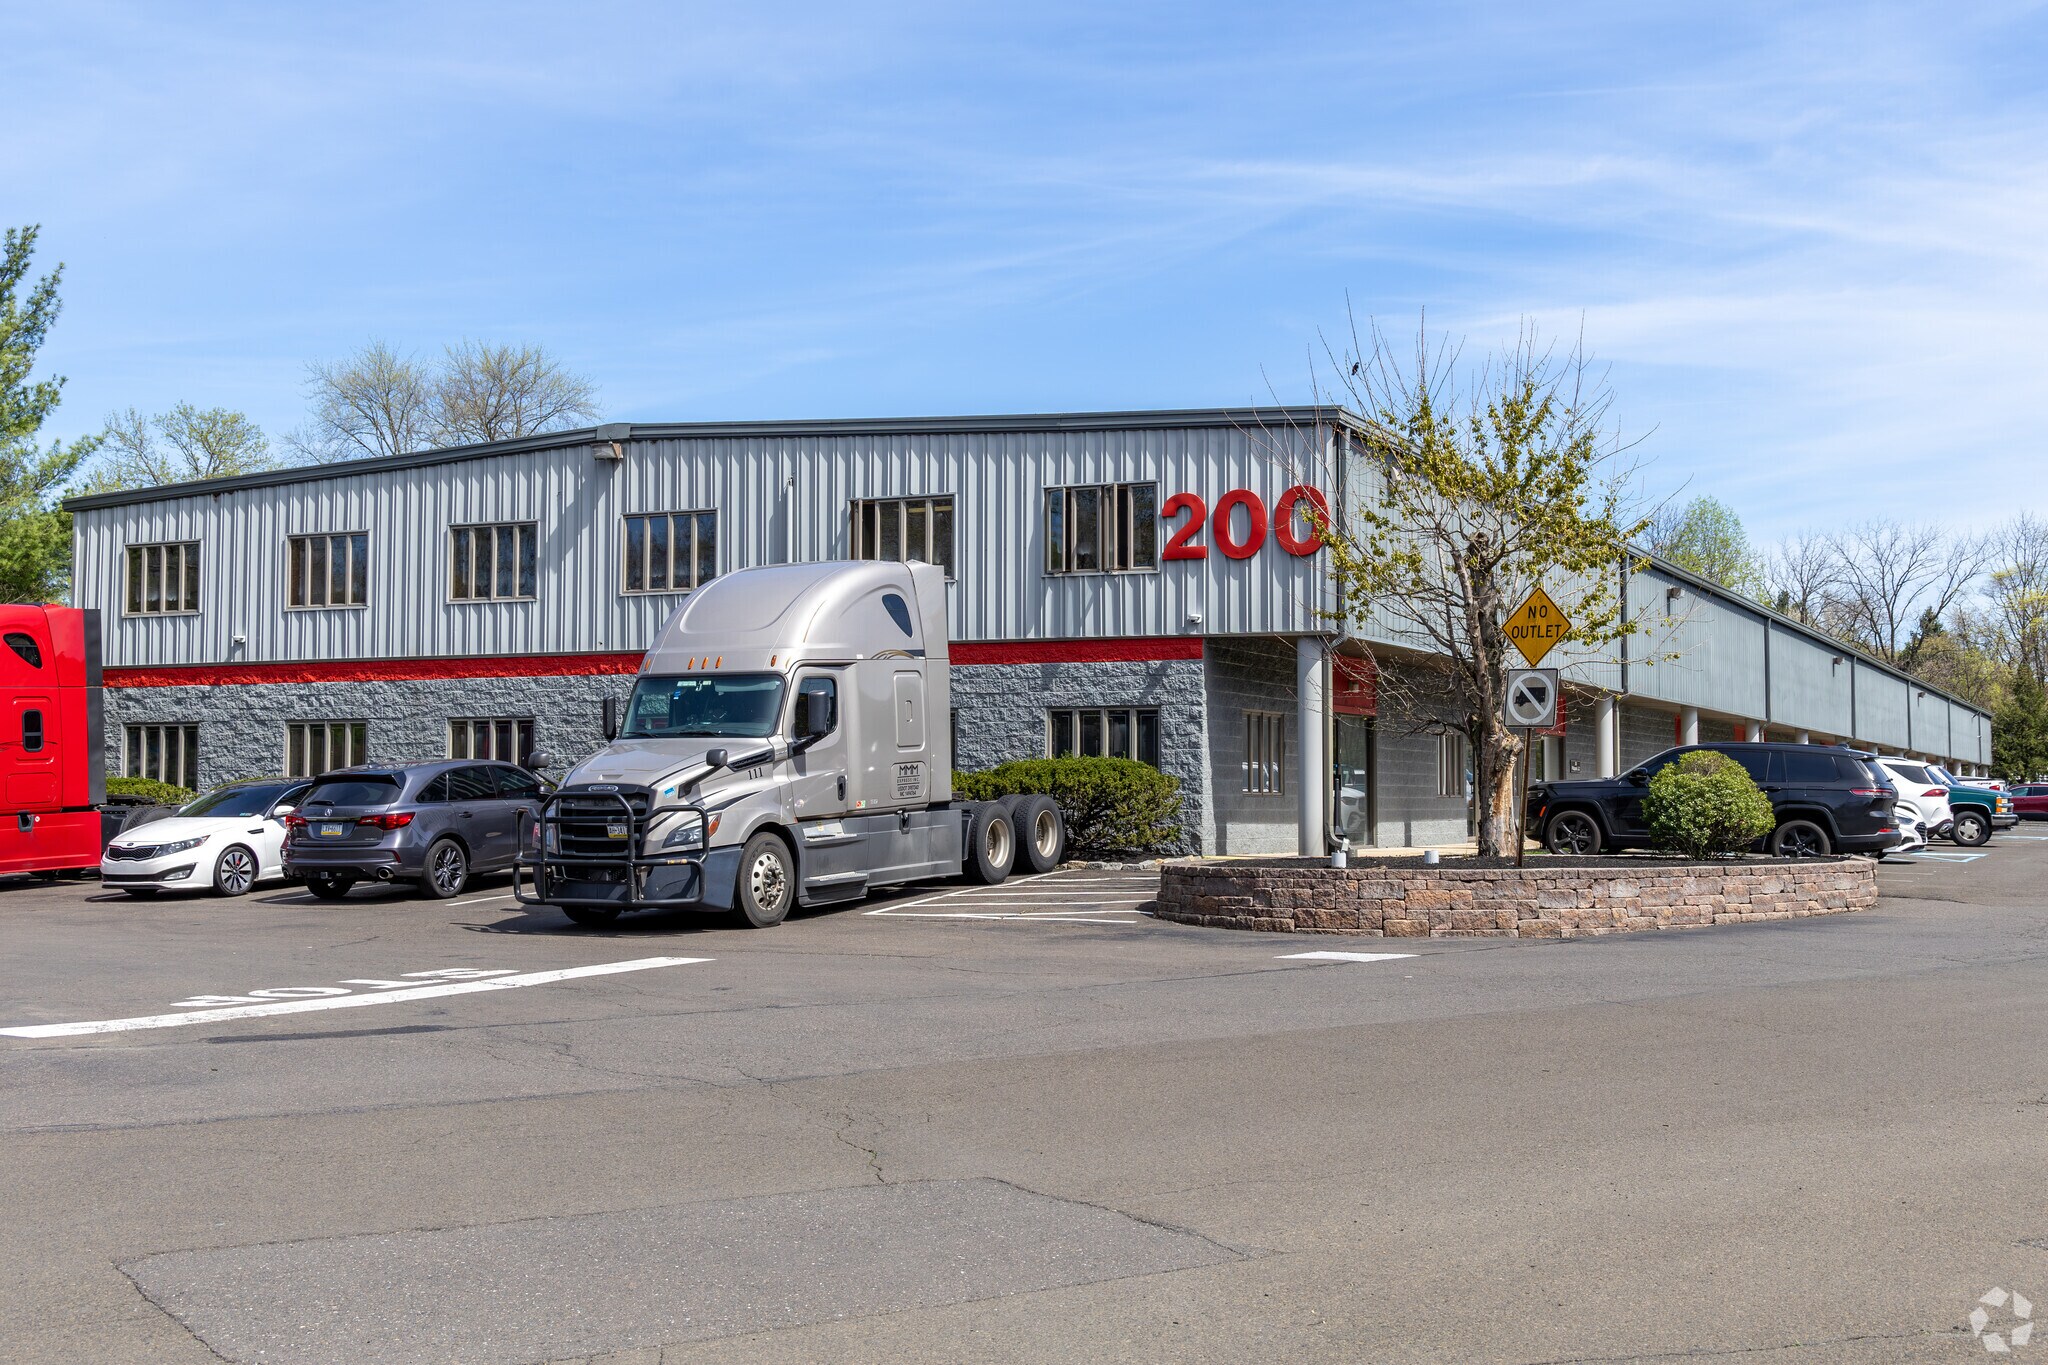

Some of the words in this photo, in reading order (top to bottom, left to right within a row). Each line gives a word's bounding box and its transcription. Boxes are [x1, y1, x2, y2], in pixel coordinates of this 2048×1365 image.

[1162, 485, 1331, 560] 200
[1527, 605, 1548, 619] NO
[1511, 624, 1562, 639] OUTLET
[748, 767, 763, 780] 111
[899, 764, 918, 775] MMM
[169, 967, 521, 1007] STOP
